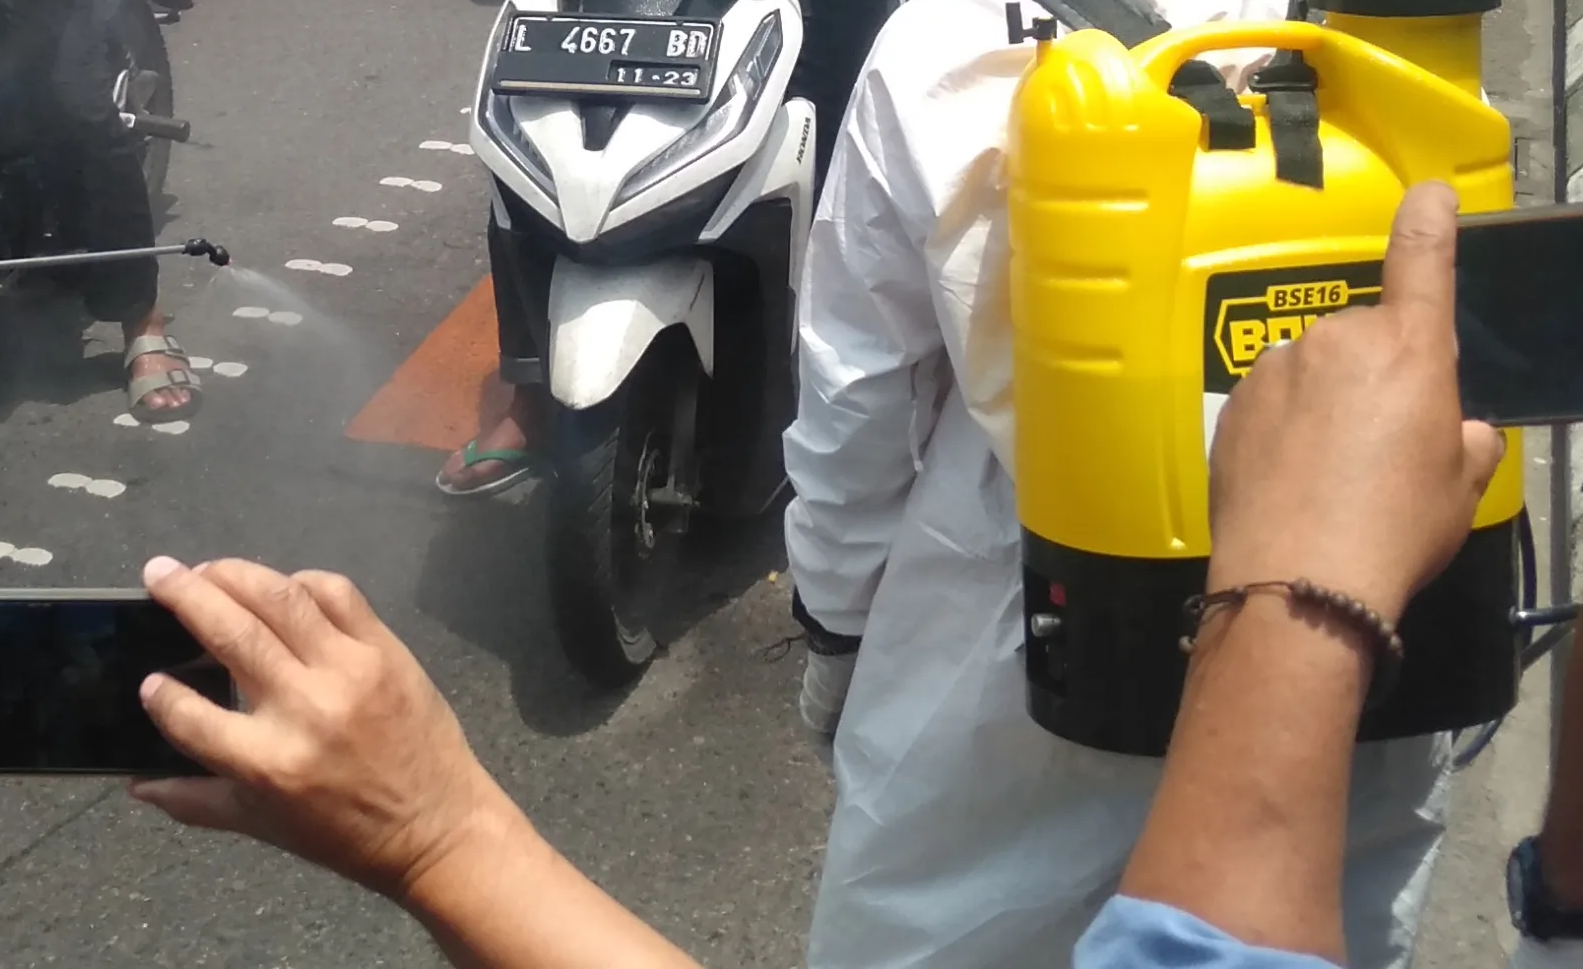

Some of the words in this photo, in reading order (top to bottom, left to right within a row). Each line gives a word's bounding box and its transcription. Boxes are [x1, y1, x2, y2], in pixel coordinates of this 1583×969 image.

[514, 24, 532, 52] L
[560, 26, 636, 56] 4667
[1273, 284, 1341, 308] BSE16
